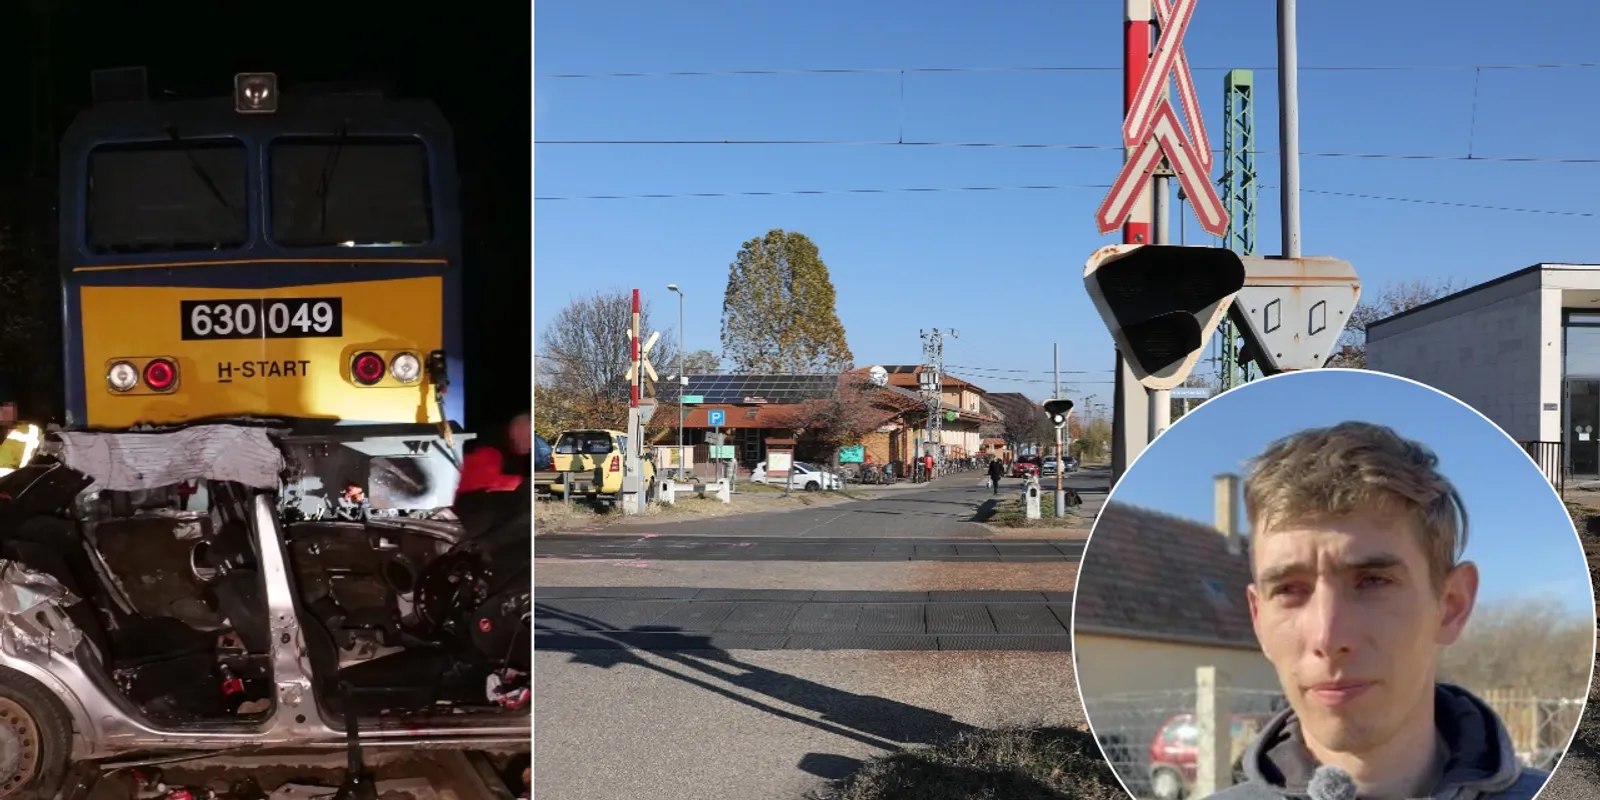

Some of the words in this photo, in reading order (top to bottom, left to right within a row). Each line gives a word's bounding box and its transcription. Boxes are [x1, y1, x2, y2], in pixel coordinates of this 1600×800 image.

[191, 304, 256, 335] 630
[268, 302, 333, 334] 049
[217, 360, 310, 382] H-START
[712, 412, 721, 423] P
